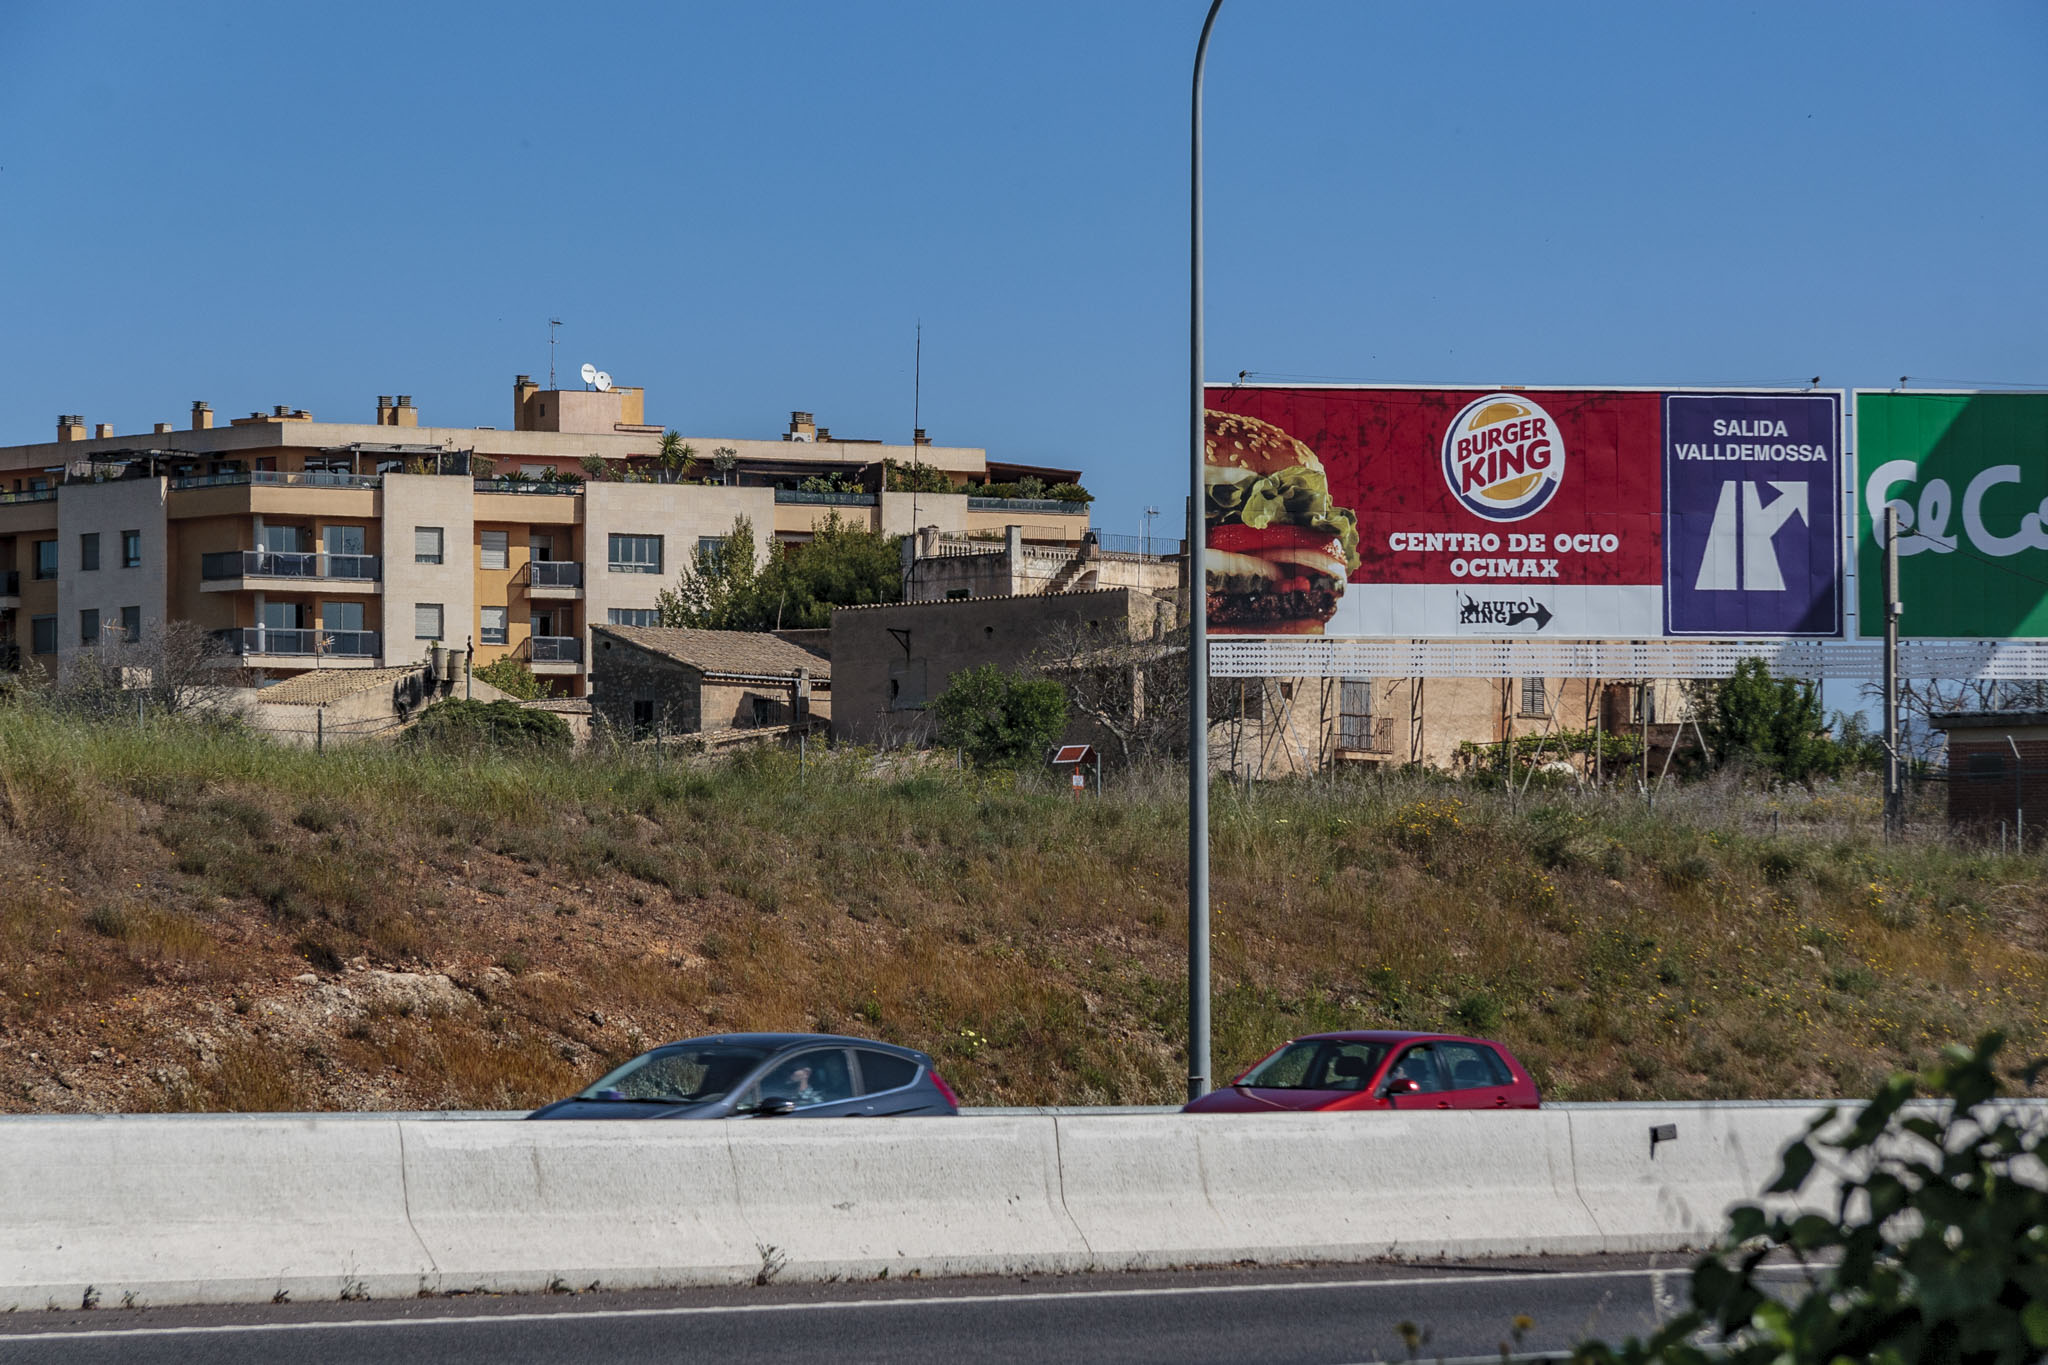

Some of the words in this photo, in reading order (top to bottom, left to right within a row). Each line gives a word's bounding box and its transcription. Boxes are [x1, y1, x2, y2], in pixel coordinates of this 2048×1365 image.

[1713, 419, 1789, 437] SALIDA
[1457, 418, 1547, 463] BURGER
[1675, 443, 1828, 462] VALLDEMOSSA
[1461, 438, 1551, 495] KING
[1389, 532, 1500, 552] CENTRO
[1508, 533, 1546, 552] DE
[1553, 533, 1619, 553] OCIO
[1450, 558, 1559, 578] OCIMAX
[1460, 610, 1507, 624] KING
[1480, 601, 1529, 614] AUTO
